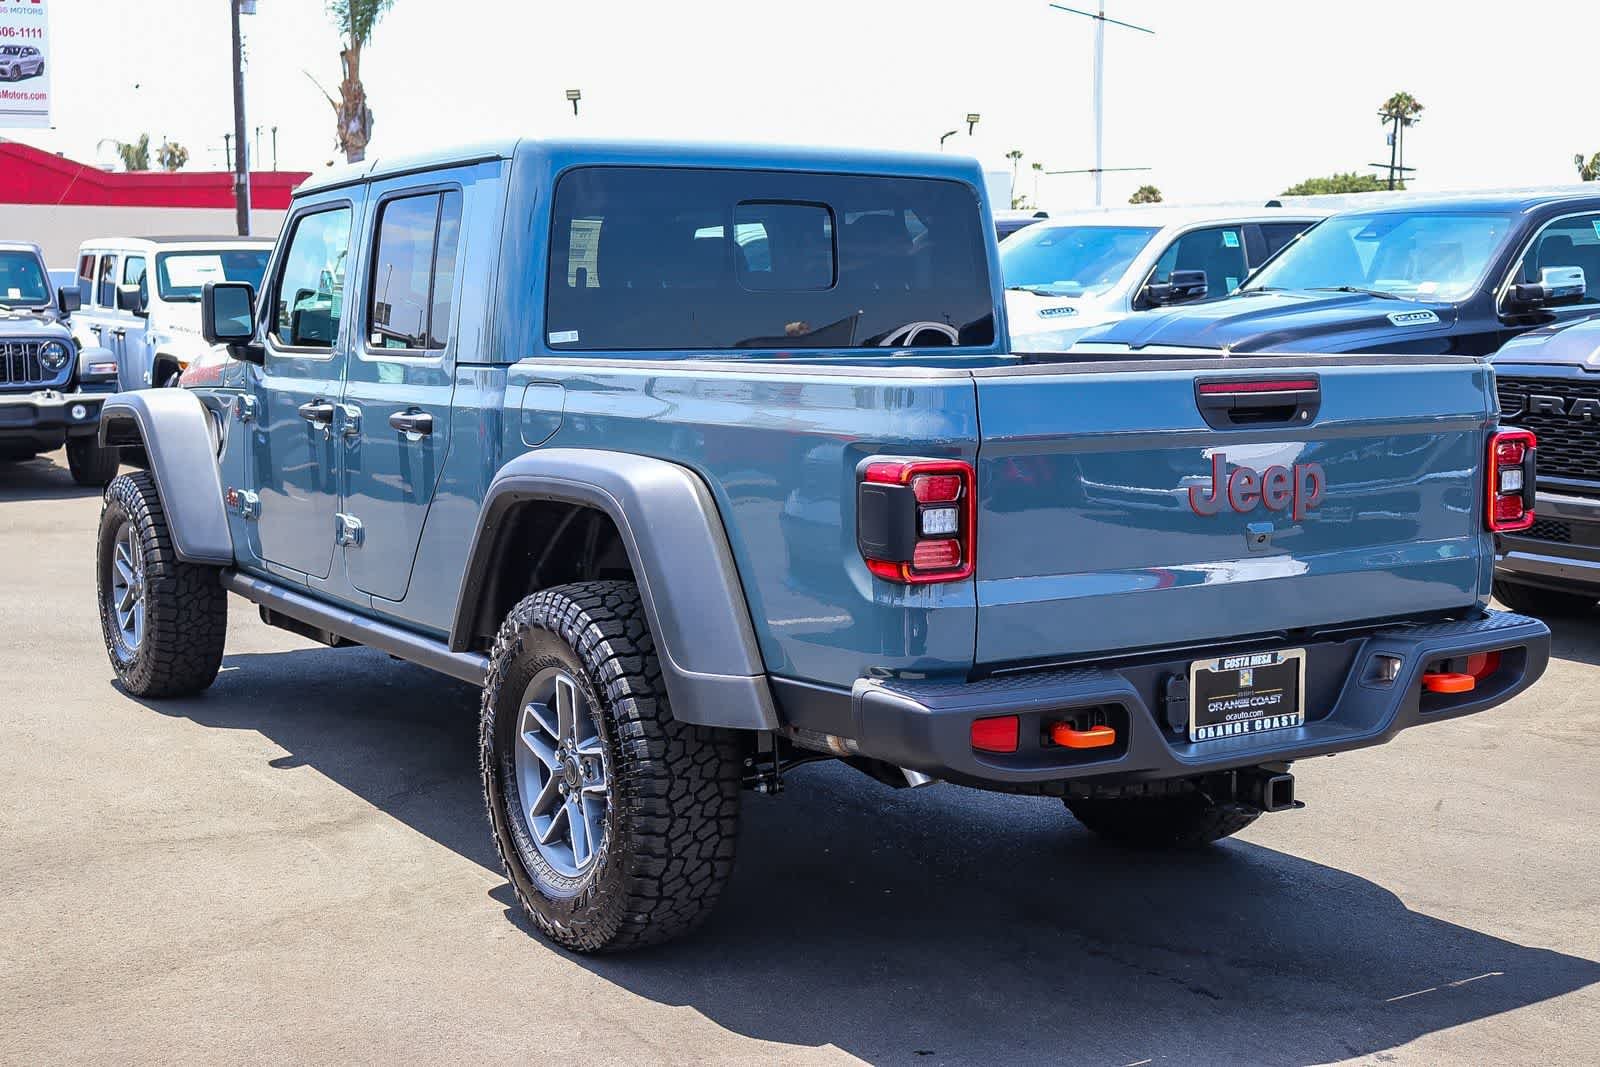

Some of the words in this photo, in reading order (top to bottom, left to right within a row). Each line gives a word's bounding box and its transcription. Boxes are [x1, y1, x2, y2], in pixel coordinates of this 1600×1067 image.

[10, 7, 43, 15] MOTORS
[0, 26, 42, 38] 06-1111
[1188, 453, 1326, 521] Jeep
[1224, 655, 1250, 669] COSTA
[1250, 654, 1272, 667] MESA
[1208, 697, 1250, 712] ORANGE
[1250, 694, 1283, 707] COAST
[1225, 709, 1264, 721] ocauto.com
[1198, 721, 1249, 739] ORANGE
[1255, 714, 1297, 731] COAST
